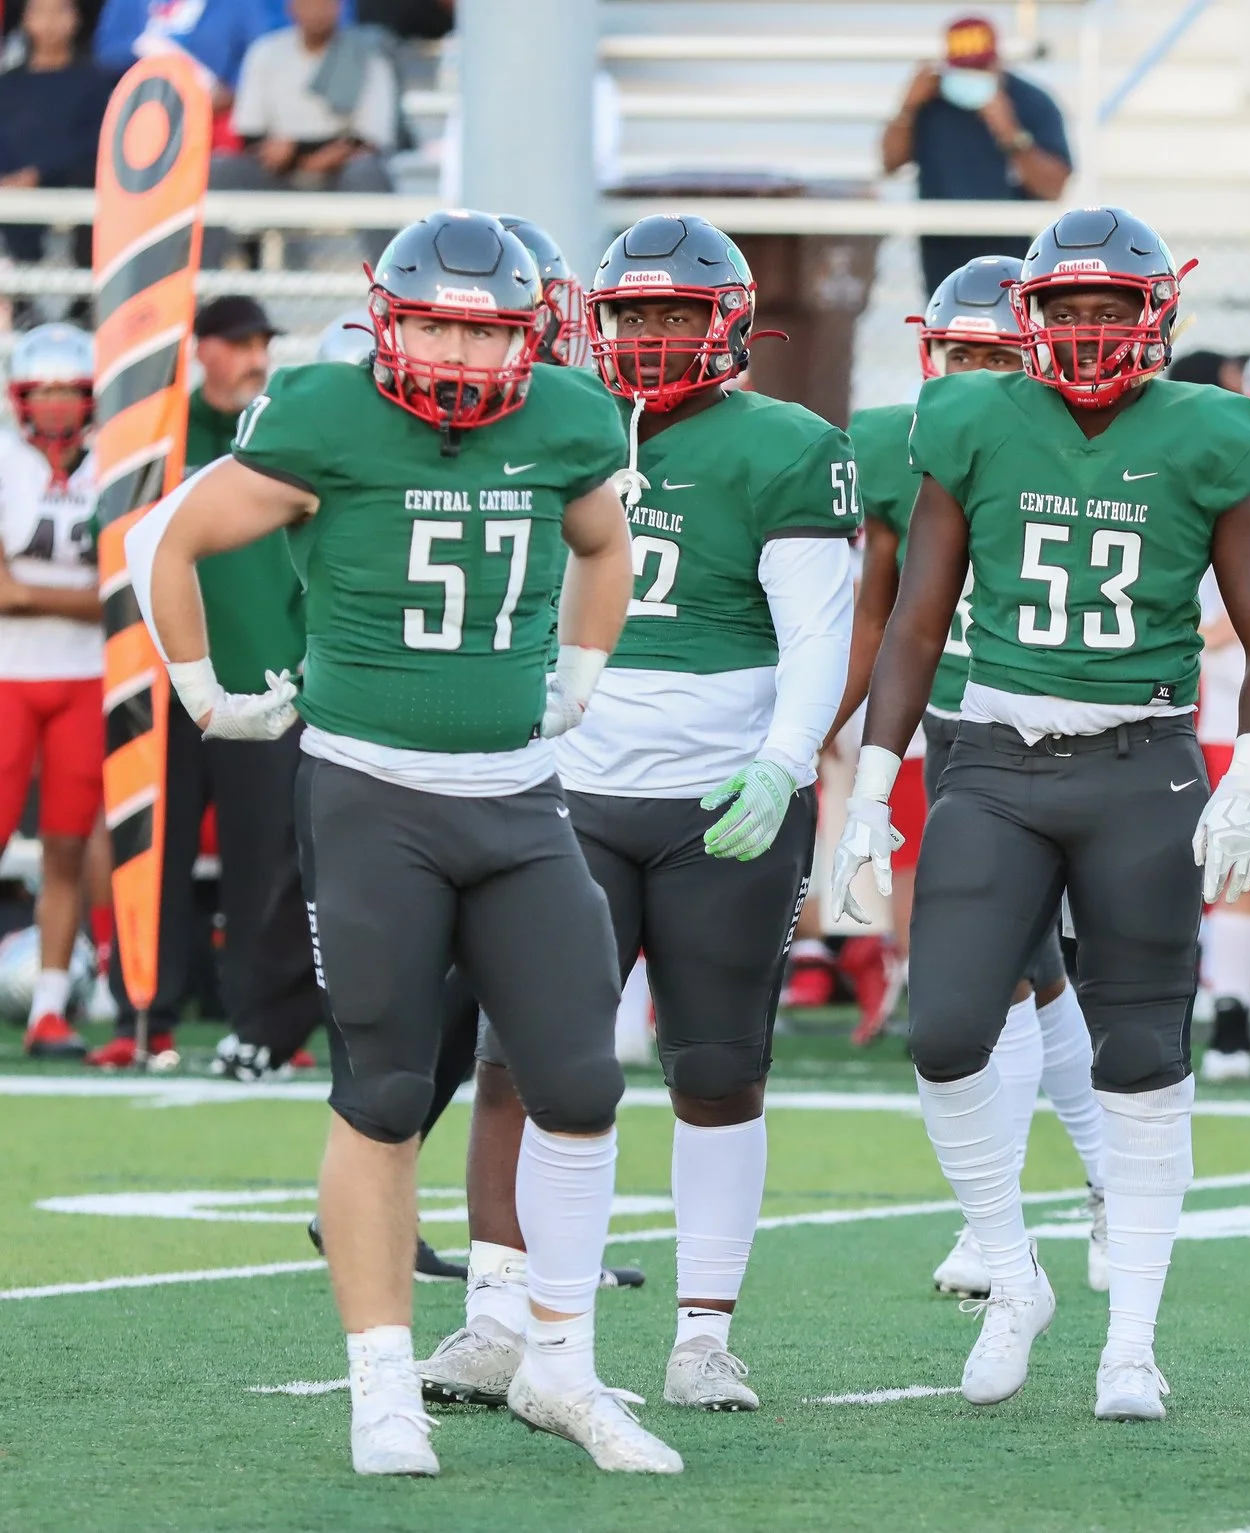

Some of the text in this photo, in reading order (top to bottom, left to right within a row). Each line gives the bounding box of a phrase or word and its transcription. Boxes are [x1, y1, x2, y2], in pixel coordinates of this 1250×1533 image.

[1058, 260, 1100, 272] Riddell
[444, 292, 490, 305] Riddell
[405, 489, 533, 512] CENTRAL CATHOLIC
[830, 460, 859, 517] 52
[1020, 491, 1148, 523] CENTRAL CATHOLIC
[626, 504, 684, 533] CATHOLIC
[403, 518, 533, 651] 57
[626, 534, 681, 618] 2
[1017, 520, 1143, 649] 53
[1157, 686, 1171, 698] XL
[782, 876, 811, 955] IRISH
[306, 901, 327, 990] IRISH
